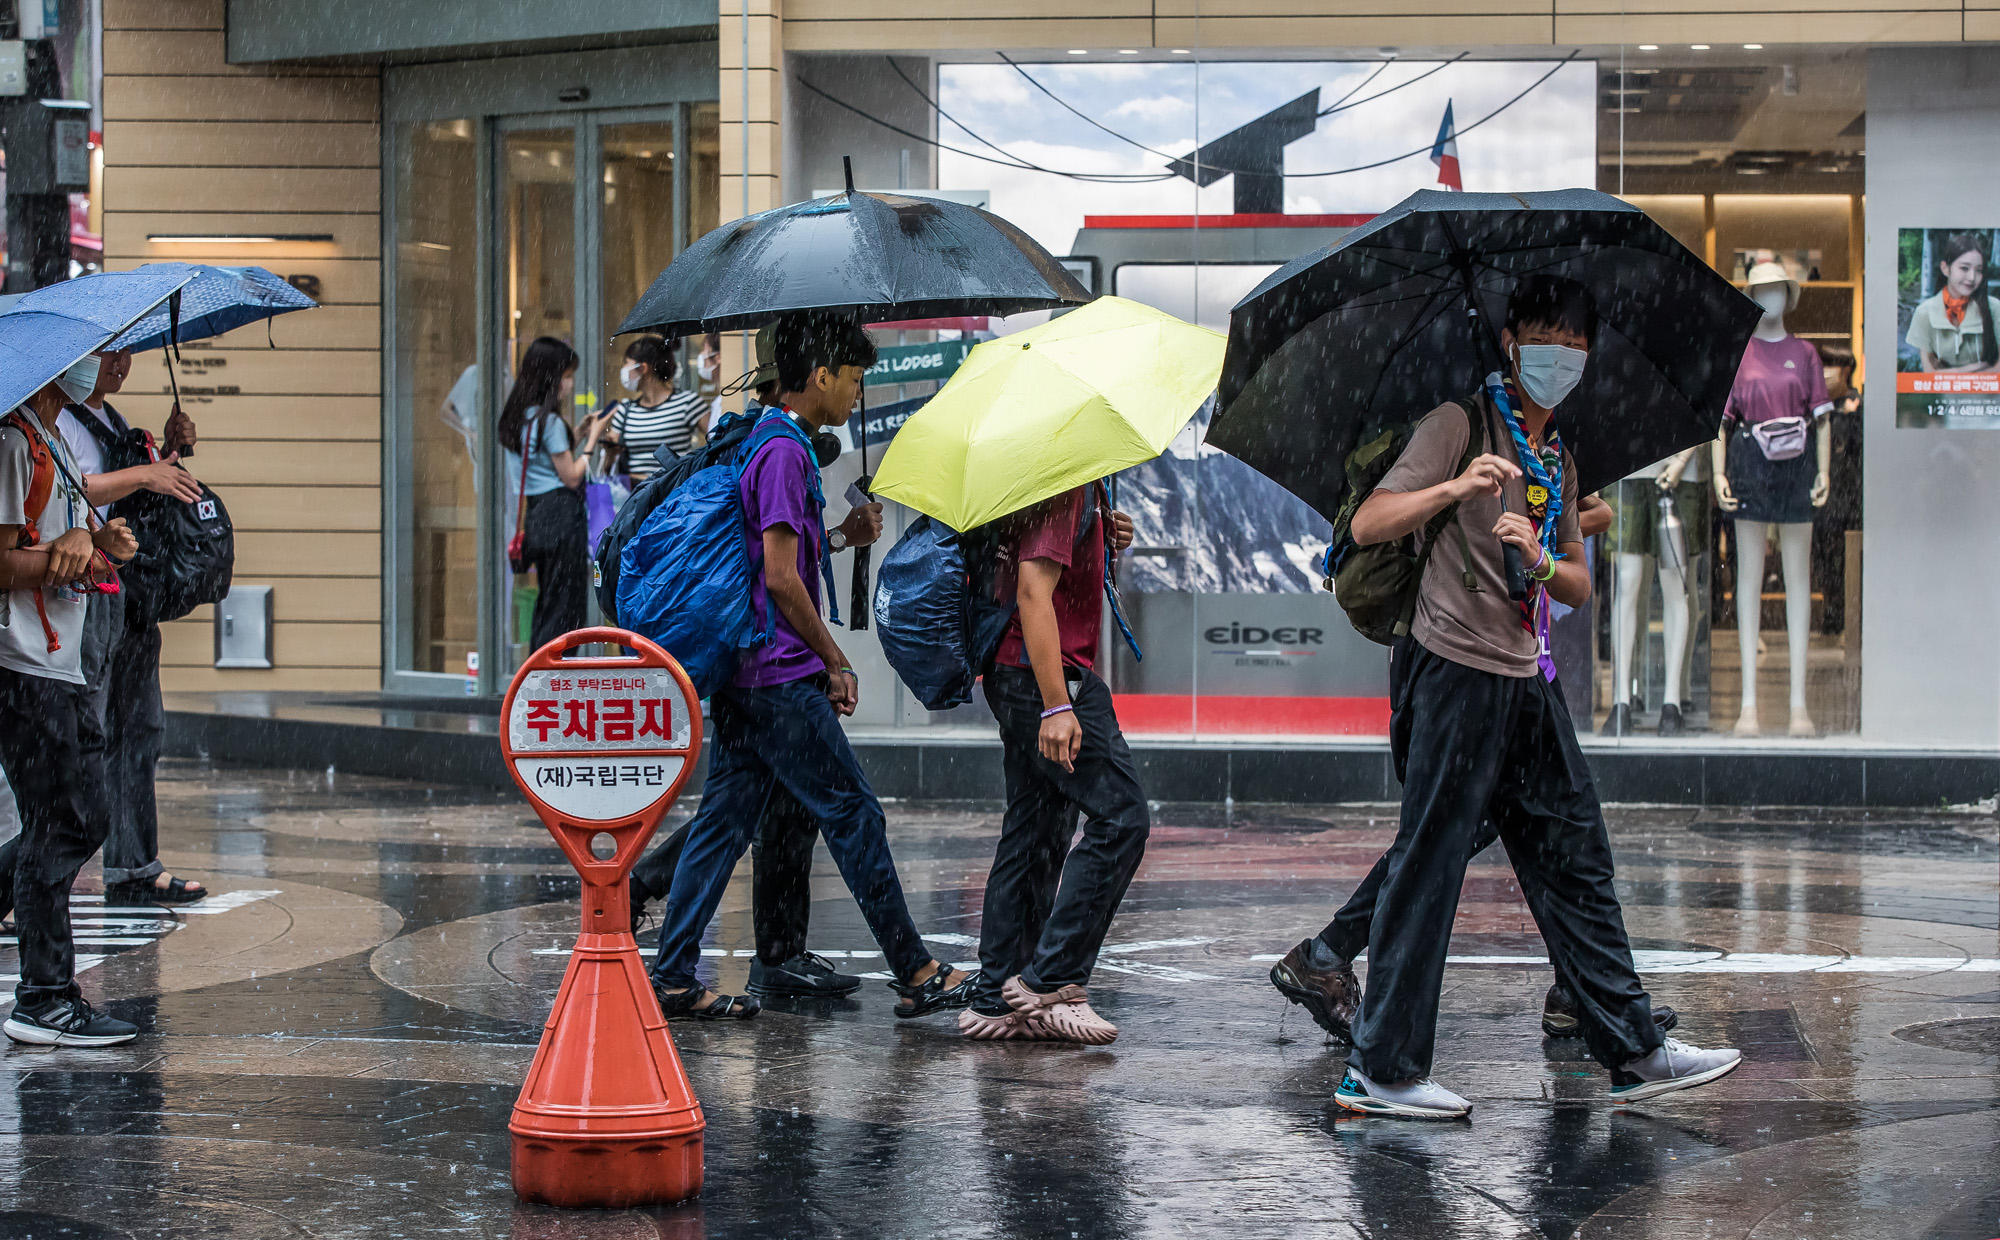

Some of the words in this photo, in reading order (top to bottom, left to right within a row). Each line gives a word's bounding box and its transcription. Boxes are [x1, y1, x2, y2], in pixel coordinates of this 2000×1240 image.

[892, 353, 944, 371] LODGE
[550, 678, 573, 691] 협조
[577, 678, 646, 691] 부탁드립니다
[526, 698, 672, 742] 주차금지
[536, 765, 665, 788] (재)국립극단
